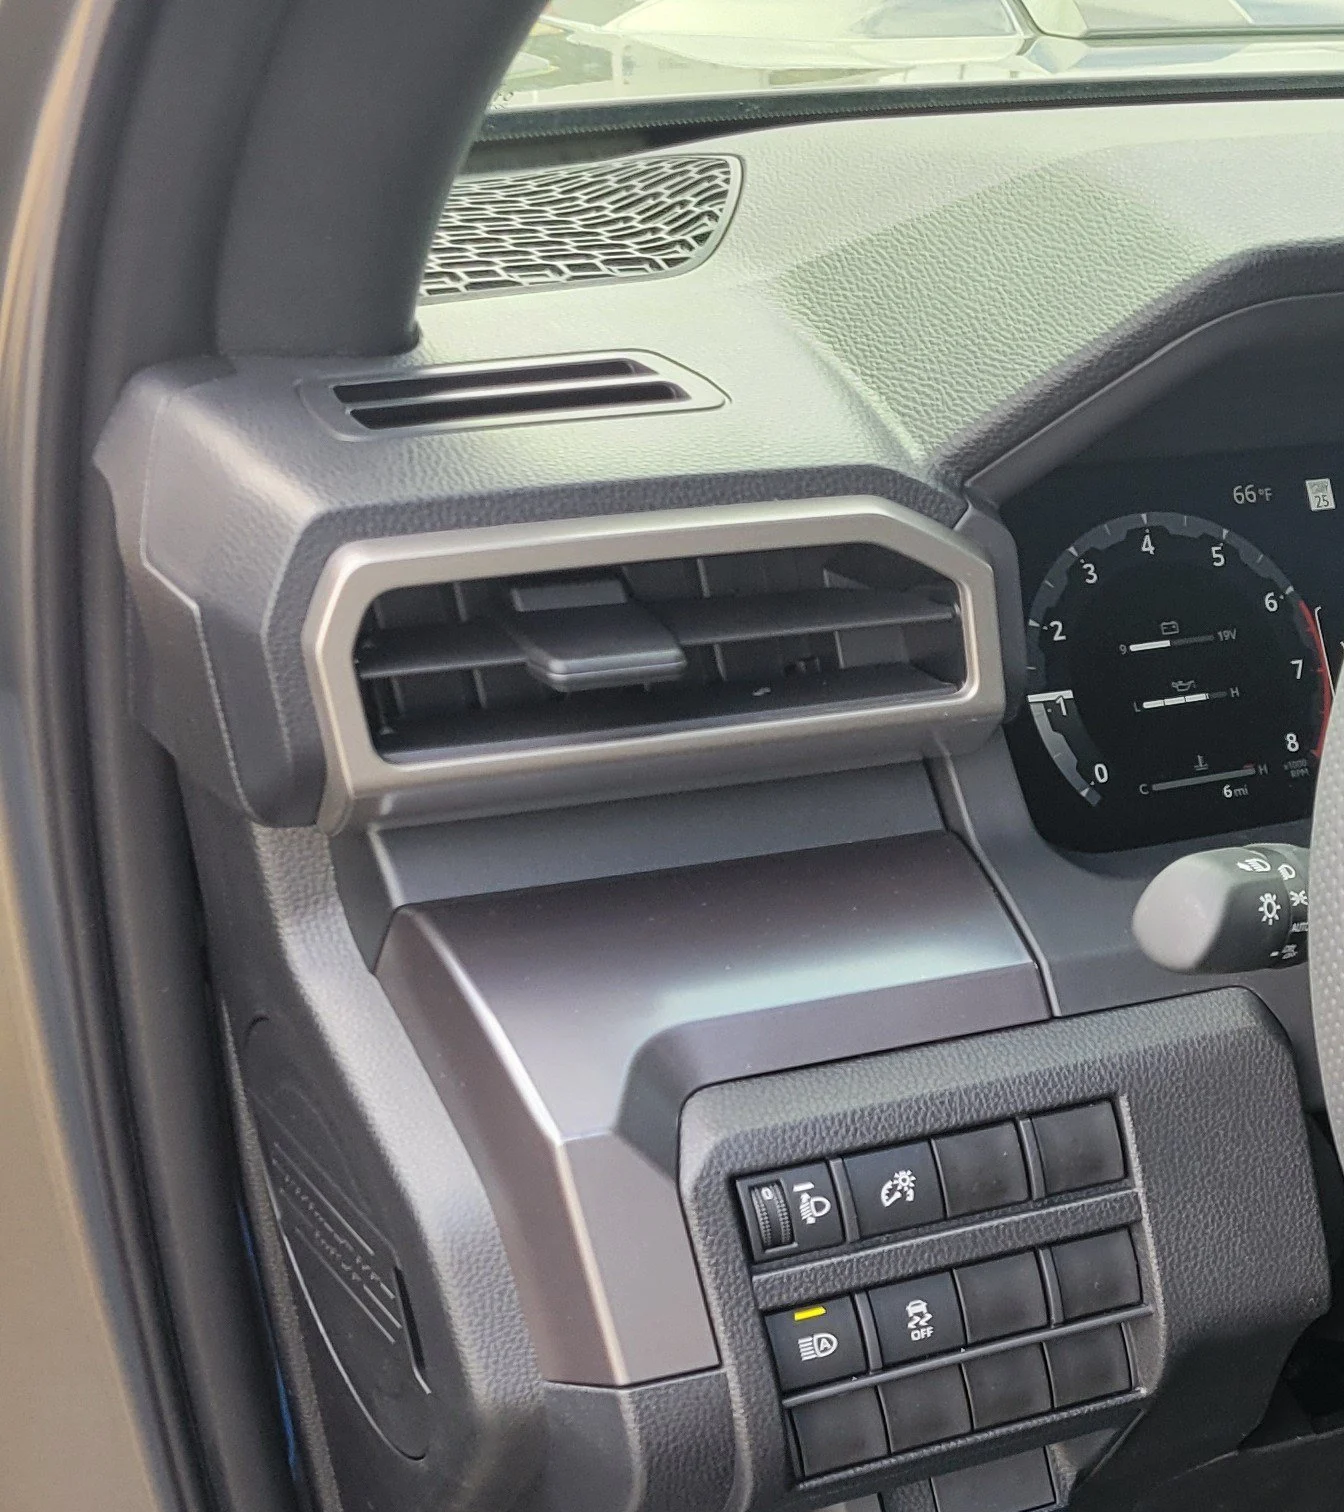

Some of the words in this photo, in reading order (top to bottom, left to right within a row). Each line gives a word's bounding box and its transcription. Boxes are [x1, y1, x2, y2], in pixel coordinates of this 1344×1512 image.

[1313, 493, 1331, 509] 25
[1140, 533, 1155, 556] 4
[1210, 545, 1226, 567] 5
[1083, 563, 1099, 584] 3
[1264, 591, 1279, 612] 6
[1049, 620, 1067, 641] 2
[1289, 659, 1305, 680] 7
[1055, 694, 1069, 716] 1
[1284, 731, 1300, 752] 8
[1093, 762, 1109, 784] 0
[910, 1325, 934, 1342] OFF
